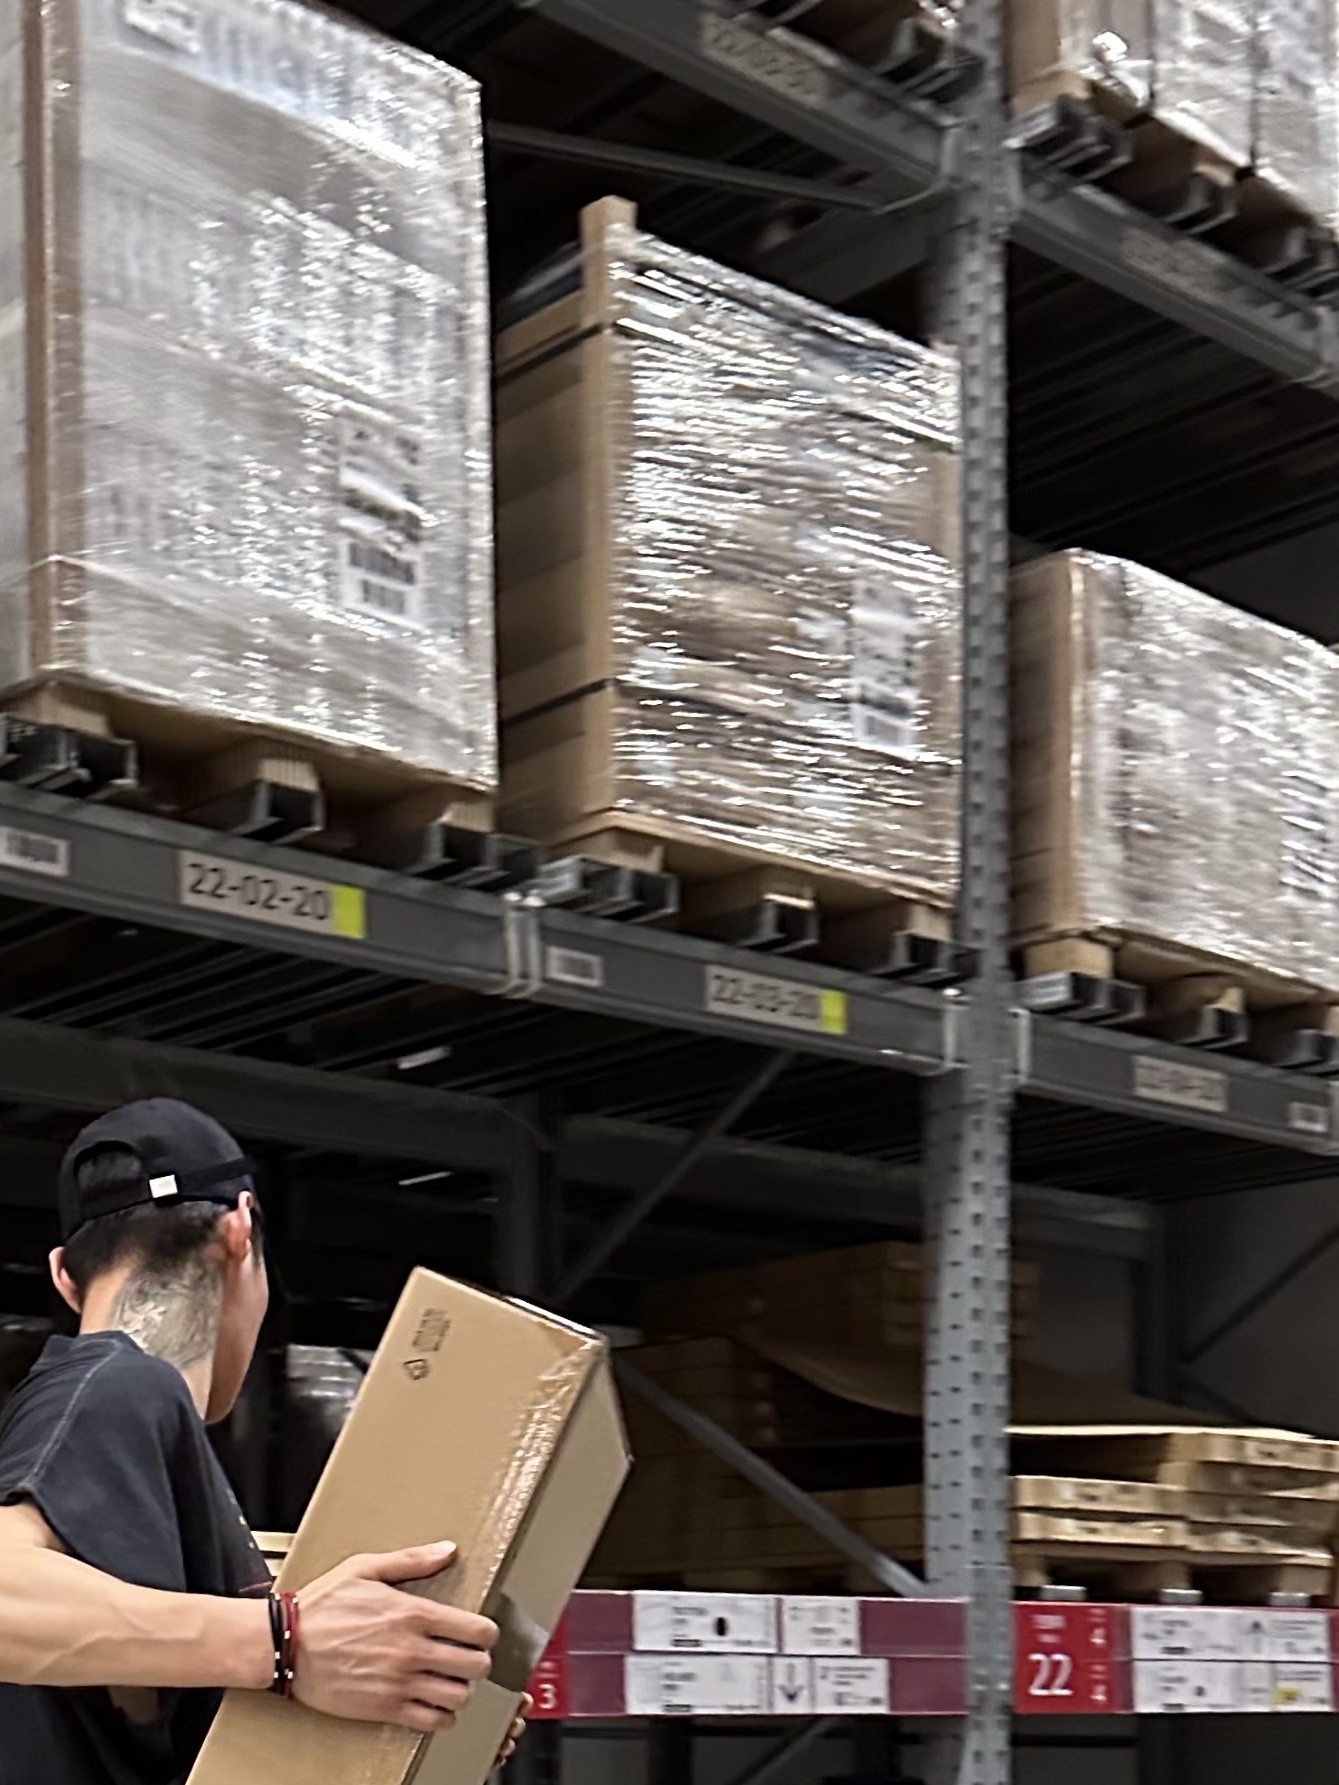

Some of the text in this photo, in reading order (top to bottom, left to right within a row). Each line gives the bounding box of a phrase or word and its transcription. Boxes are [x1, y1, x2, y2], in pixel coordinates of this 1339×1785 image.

[188, 862, 330, 921] 22-02-20
[1028, 1653, 1073, 1696] 22
[538, 1683, 559, 1710] 3
